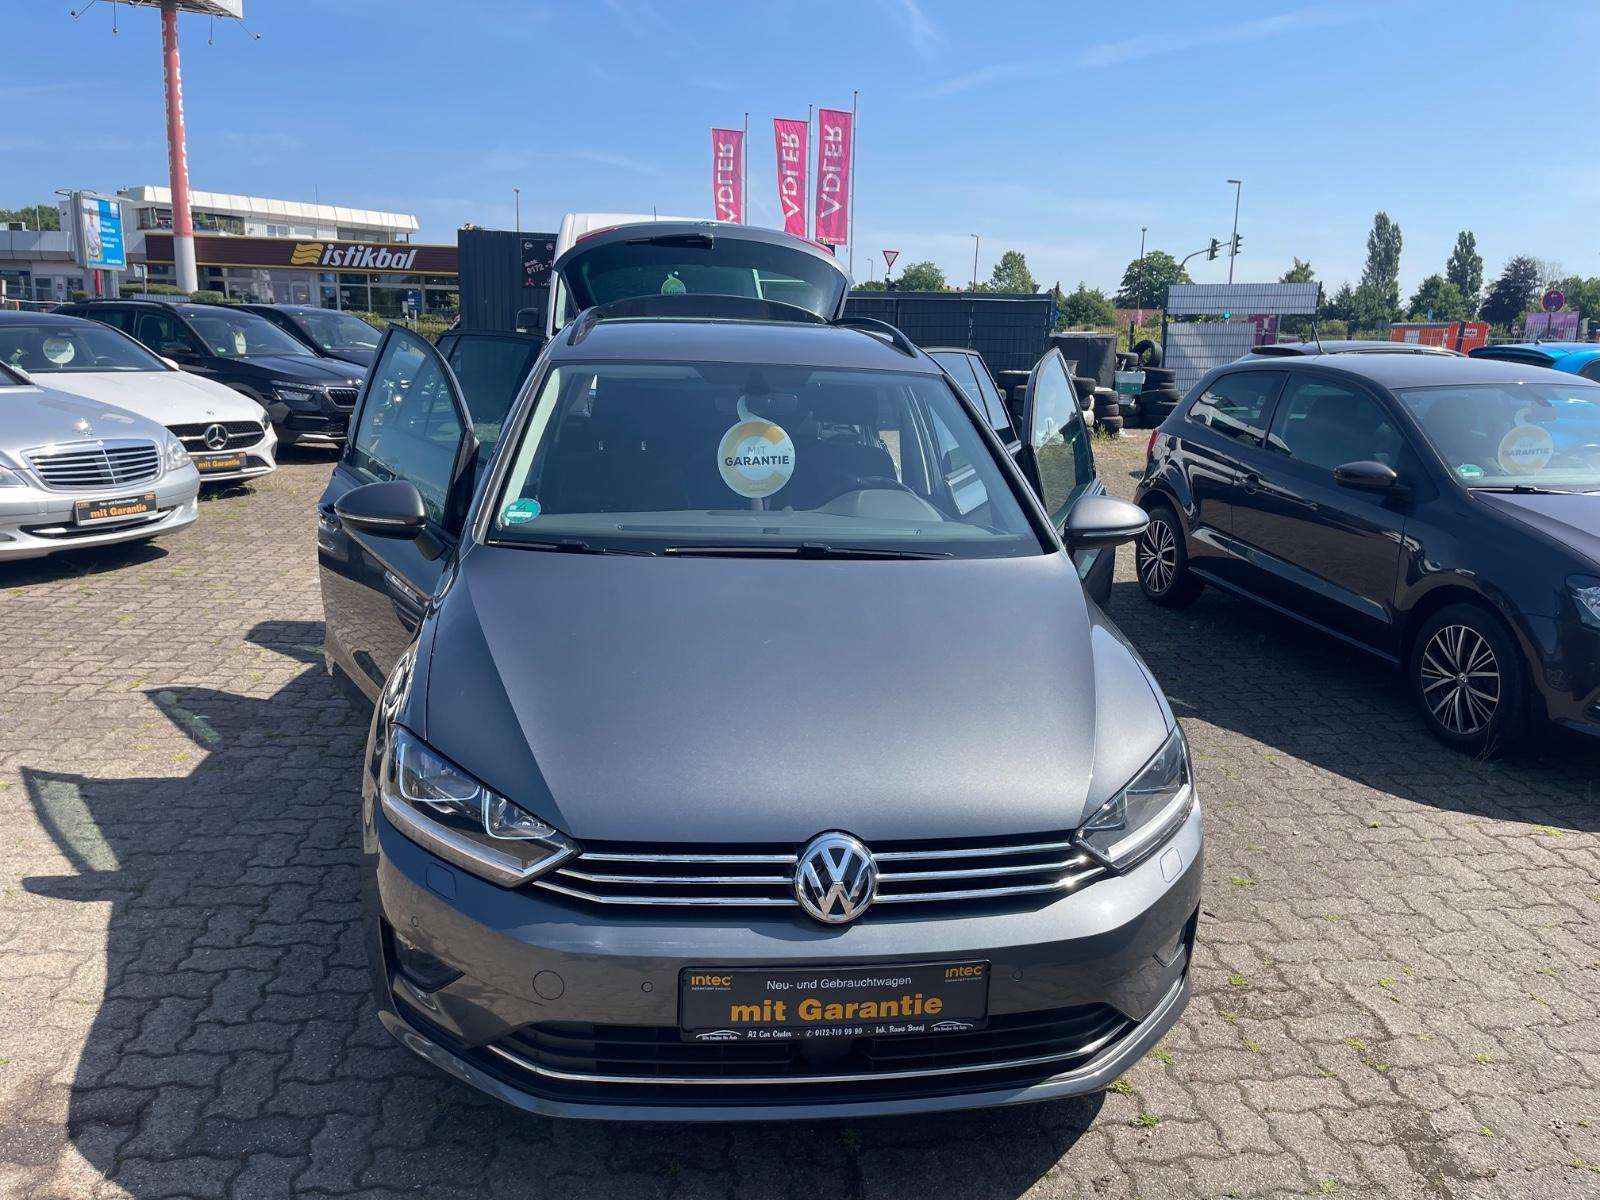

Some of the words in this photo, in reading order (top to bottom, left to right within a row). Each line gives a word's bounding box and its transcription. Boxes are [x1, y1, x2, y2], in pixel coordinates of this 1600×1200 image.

[322, 243, 418, 270] istikbal
[747, 445, 767, 455] MIT
[724, 455, 790, 467] GARANTIE
[90, 507, 108, 519] mit
[109, 503, 147, 516] Garantie
[944, 965, 983, 978] intec
[691, 974, 731, 986] intec
[766, 980, 794, 990] Neu-
[796, 979, 817, 990] und
[820, 976, 912, 989] Gebrauchtwagen
[730, 999, 787, 1022] mit
[798, 993, 943, 1021] Garantie
